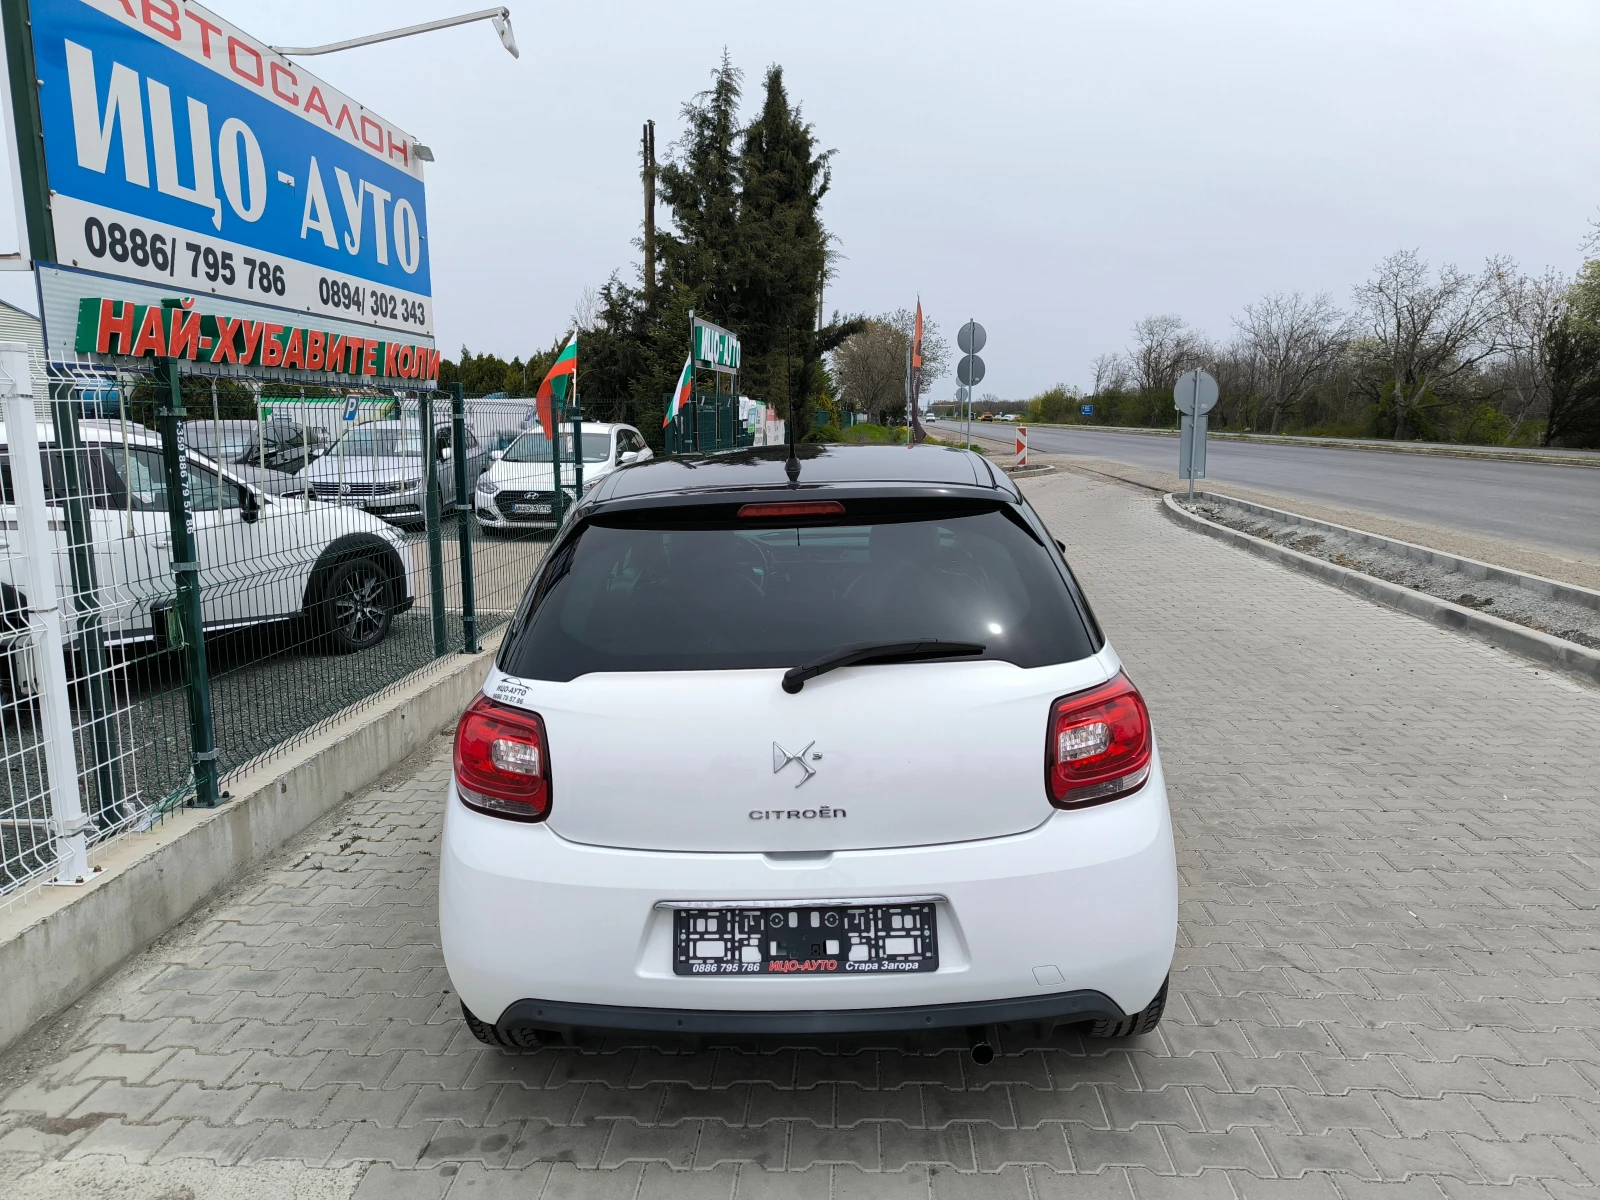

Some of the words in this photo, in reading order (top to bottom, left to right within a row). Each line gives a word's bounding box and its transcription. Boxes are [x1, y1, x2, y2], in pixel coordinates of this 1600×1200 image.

[84, 216, 177, 277] 0886/
[185, 241, 236, 286] 795
[243, 256, 286, 297] 786
[319, 276, 366, 316] 0894/
[370, 290, 398, 320] 302
[401, 298, 425, 326] 343
[96, 298, 379, 376] НАЙ-ХУБАВИТЕ
[384, 341, 441, 381] КОЛИ
[701, 326, 741, 369] ИЦО-АУТО
[176, 420, 185, 451] +359
[178, 454, 188, 478] 886
[181, 481, 190, 497] 79
[183, 500, 192, 515] 57
[185, 518, 194, 534] 86
[496, 685, 527, 697] ИЦО-АУТО
[692, 963, 718, 973] 0886
[719, 963, 740, 973] 795
[741, 962, 761, 972] 786
[768, 959, 838, 973] ИЦО-АУТО
[845, 961, 879, 972] Стара
[880, 960, 920, 972] Загора
